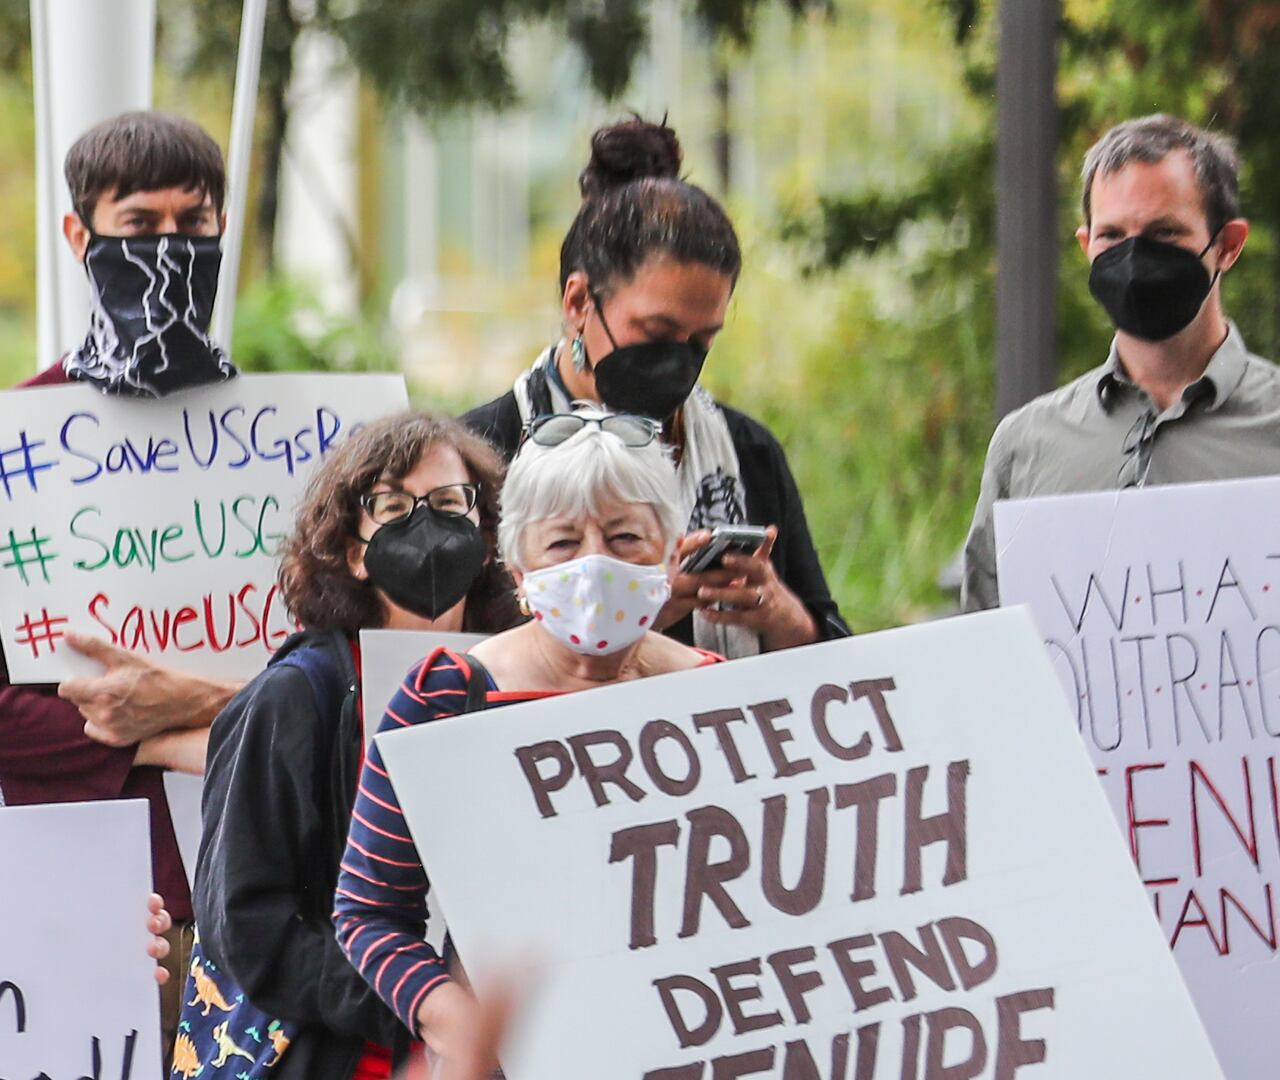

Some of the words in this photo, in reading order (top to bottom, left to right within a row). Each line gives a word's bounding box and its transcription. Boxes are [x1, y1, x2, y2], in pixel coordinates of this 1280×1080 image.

[514, 674, 906, 819] PROTECT
[608, 759, 972, 952] TRUTH
[1097, 755, 1280, 885] EN
[651, 915, 999, 1049] DEFEND
[1153, 883, 1278, 956] AN
